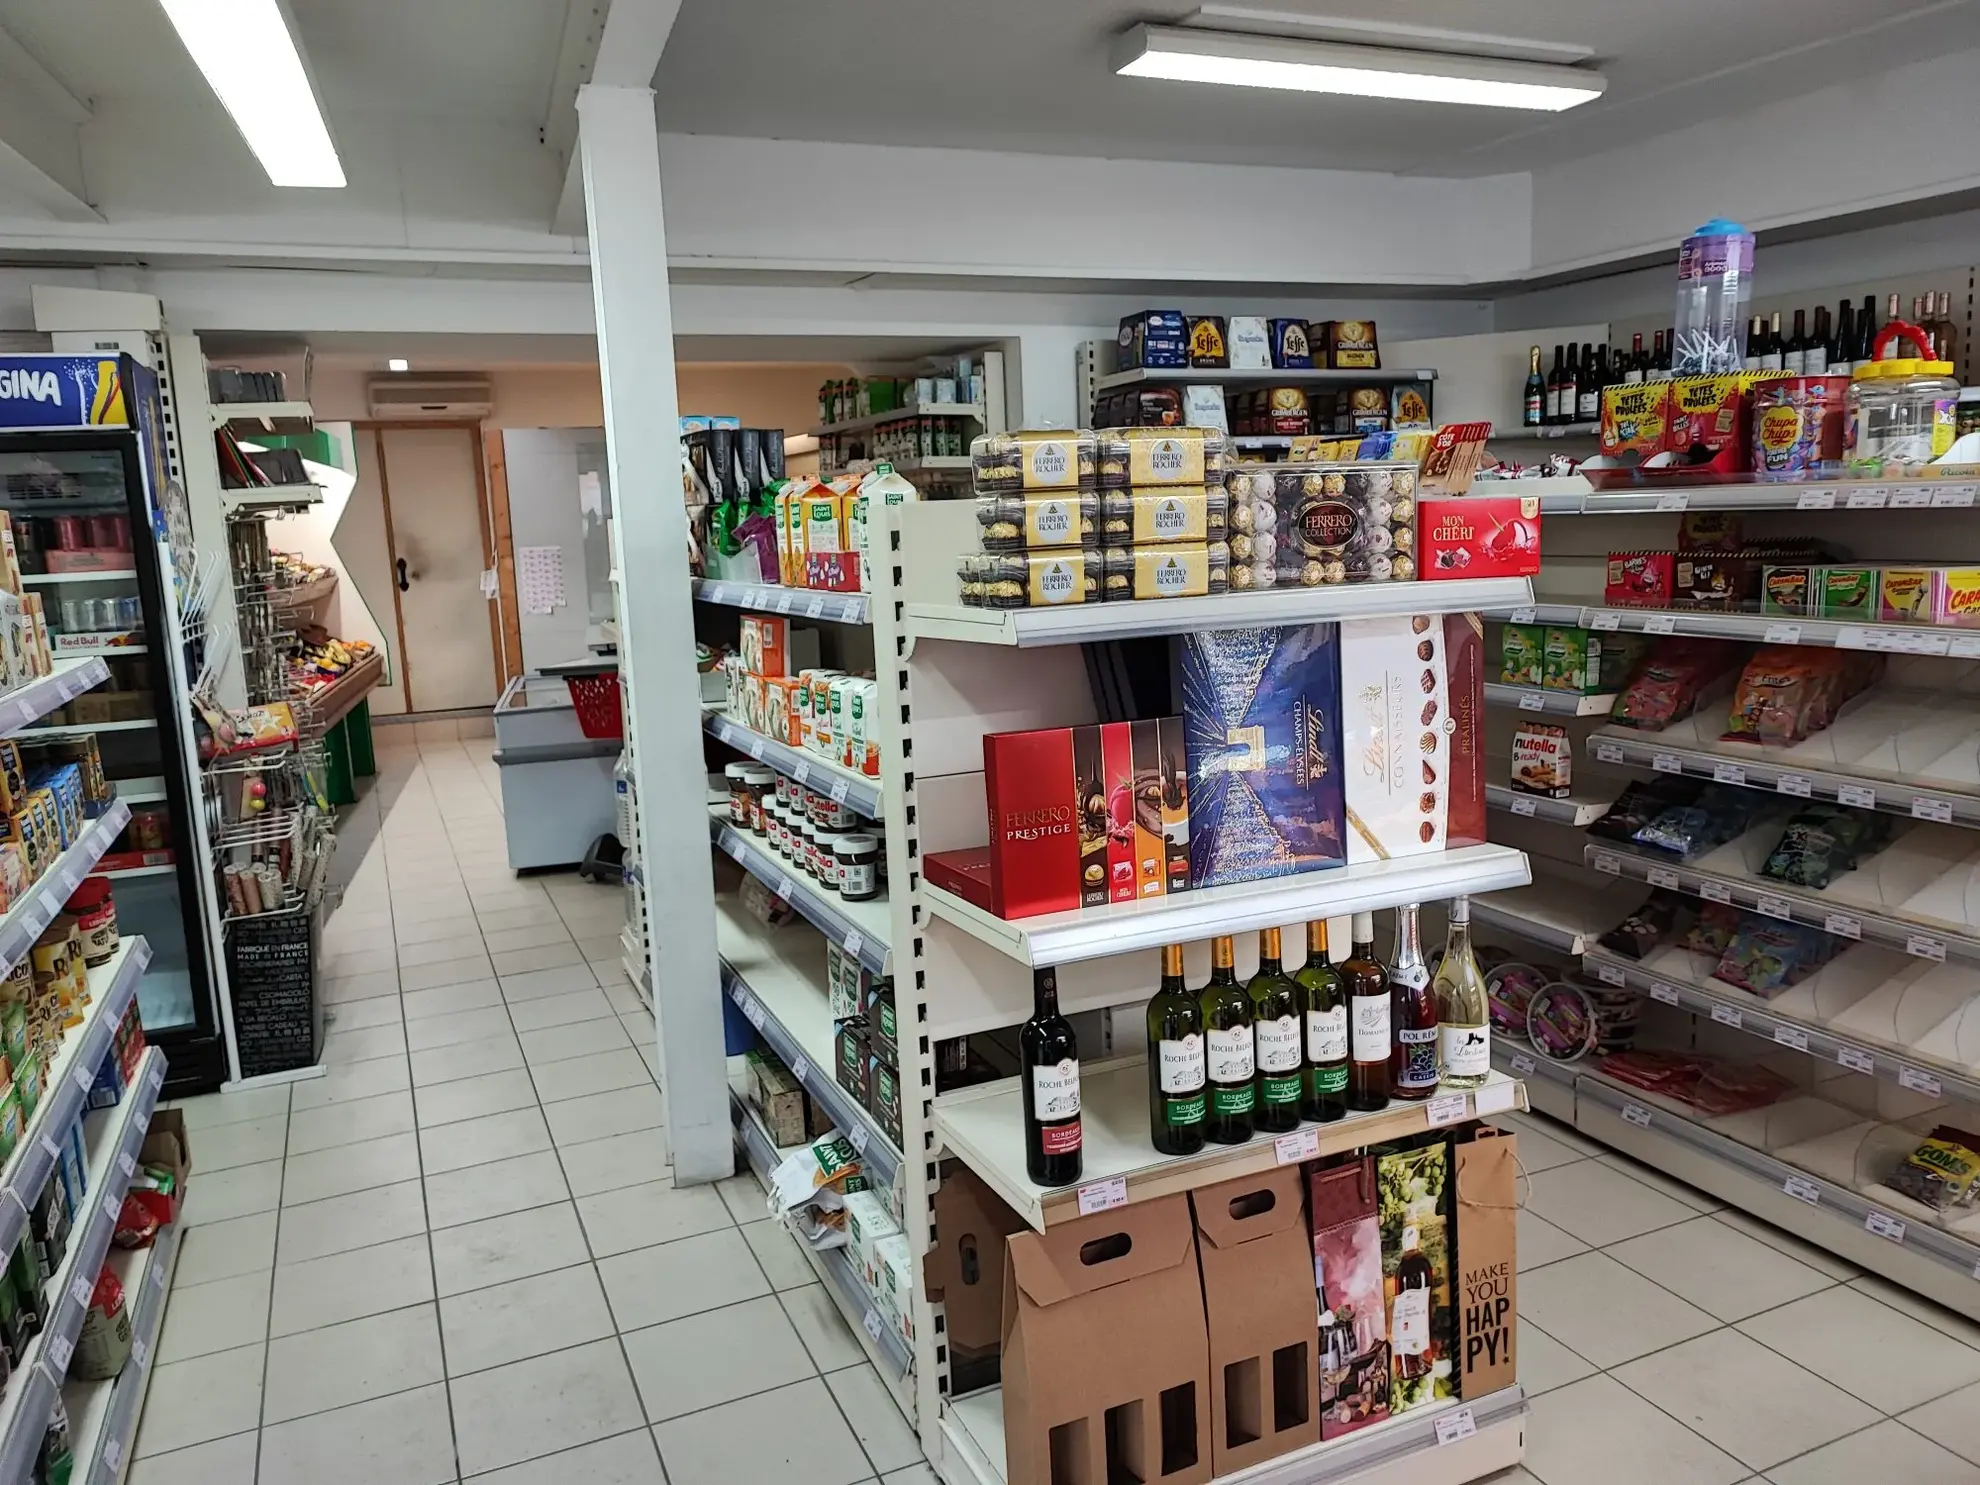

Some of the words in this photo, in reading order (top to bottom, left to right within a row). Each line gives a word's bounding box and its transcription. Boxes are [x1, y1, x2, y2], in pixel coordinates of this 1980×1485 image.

[1195, 334, 1219, 352] Leffe
[1286, 335, 1305, 353] Leffe
[1402, 399, 1423, 421] Leffe
[1763, 416, 1798, 428] Chupa
[1762, 427, 1797, 441] Chups
[1035, 456, 1065, 465] FERRERO
[1152, 453, 1182, 462] FERRERO
[1767, 453, 1788, 463] FUN
[1035, 463, 1065, 472] ROCHER
[1152, 460, 1182, 469] ROCHER
[1038, 515, 1068, 524] FERRERO
[1155, 512, 1185, 521] FERRERO
[1305, 514, 1352, 528] FERRERO
[1442, 515, 1465, 527] MON
[1038, 522, 1068, 531] ROCHER
[1155, 519, 1184, 528] ROCHER
[1304, 524, 1352, 537] COLLECTION
[1156, 569, 1186, 578] FERRERO
[1042, 575, 1072, 584] FERRERO
[1156, 576, 1185, 584] ROCHER
[1042, 582, 1072, 591] ROCHER
[60, 638, 78, 647] Red
[80, 635, 99, 645] Bull
[1391, 675, 1404, 788] CONNAISSEURS
[1515, 738, 1557, 754] nutella
[1006, 805, 1070, 828] FERRERO
[1006, 823, 1071, 840] PRESTIGE
[280, 942, 308, 951] FRANCE
[274, 950, 308, 960] FRANCE
[1313, 1025, 1334, 1033] ROCHE
[1259, 1034, 1282, 1042] ROCHE
[1403, 1032, 1418, 1040] POL
[1211, 1044, 1233, 1052] ROCHE
[1164, 1053, 1187, 1063] ROCHE
[1039, 1080, 1062, 1089] ROCHE
[1465, 1263, 1509, 1286] MAKE
[1466, 1277, 1508, 1304] YOU
[1466, 1297, 1509, 1336] HAP
[1466, 1327, 1510, 1373] PY!
